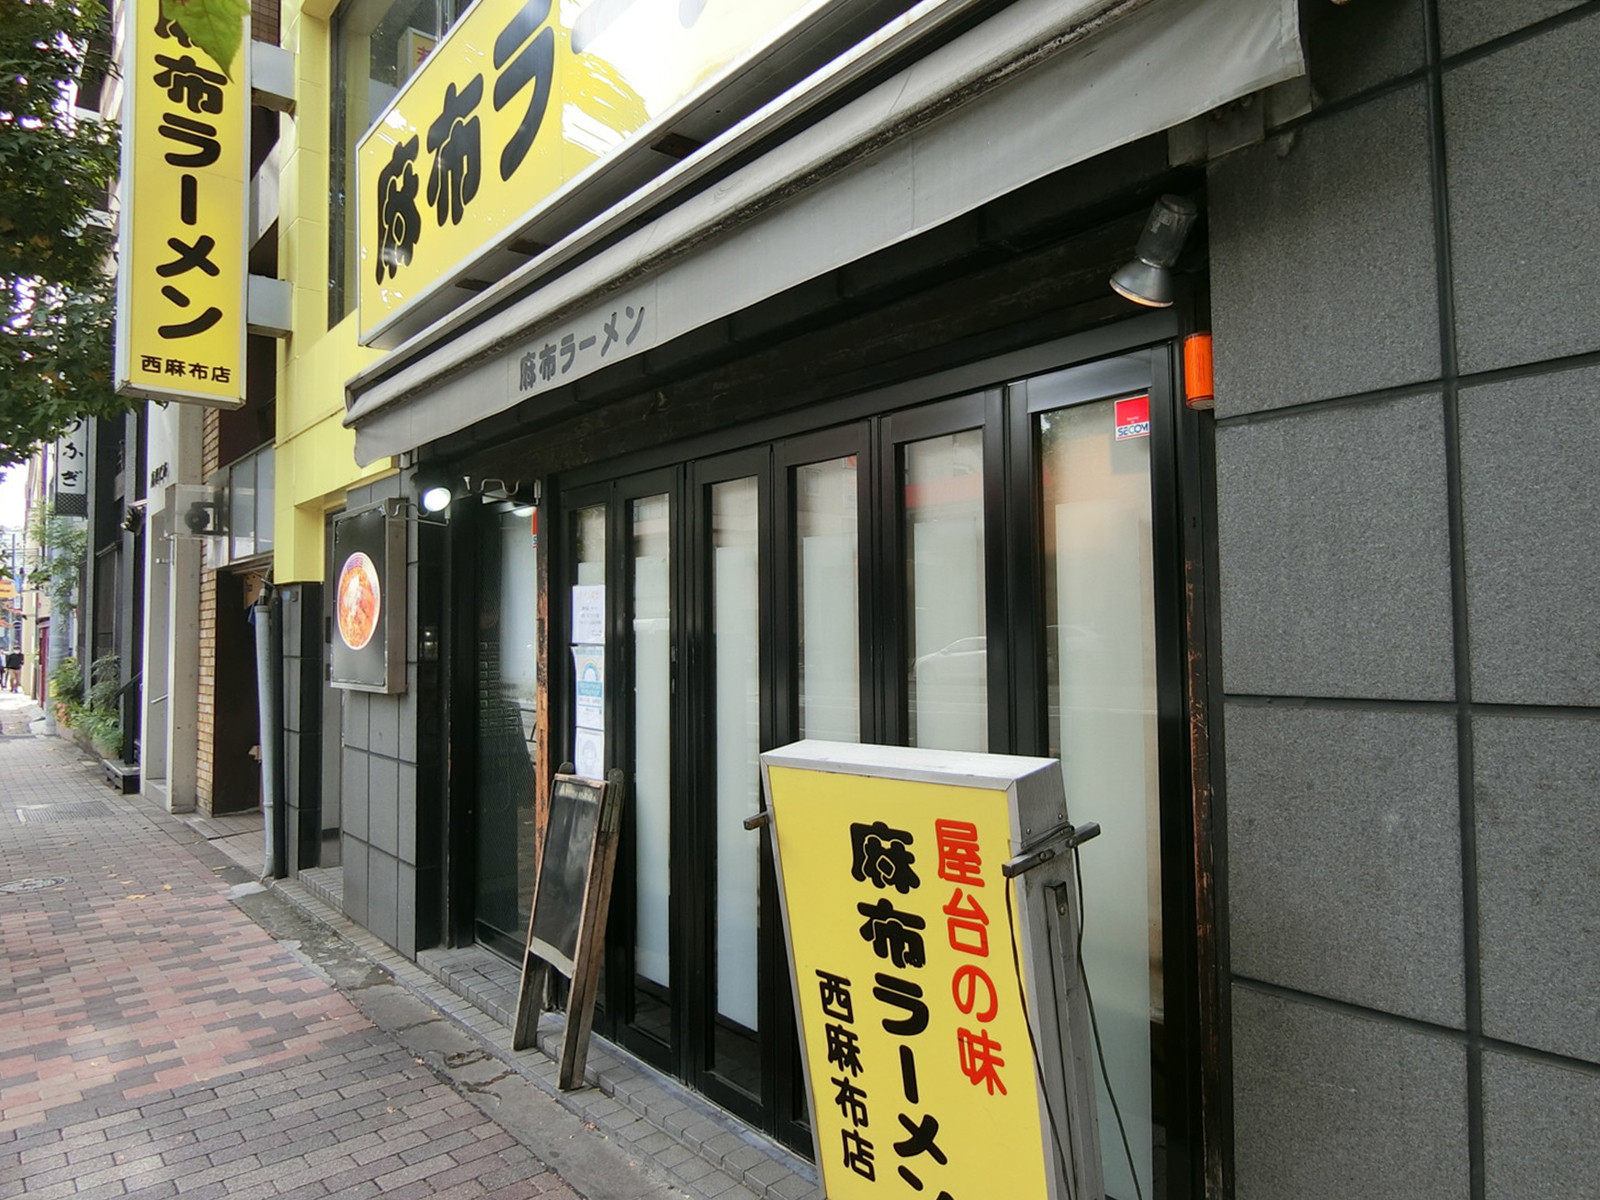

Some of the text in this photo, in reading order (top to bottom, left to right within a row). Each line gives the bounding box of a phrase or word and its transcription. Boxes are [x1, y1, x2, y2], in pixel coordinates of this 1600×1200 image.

[154, 0, 228, 340] 布ラーメン
[140, 354, 231, 384] 西麻布店
[519, 305, 645, 392] 麻布ラーメン
[1118, 424, 1148, 437] SECOM
[935, 819, 1007, 1096] 屋台の味
[815, 969, 876, 1182] 西麻布店
